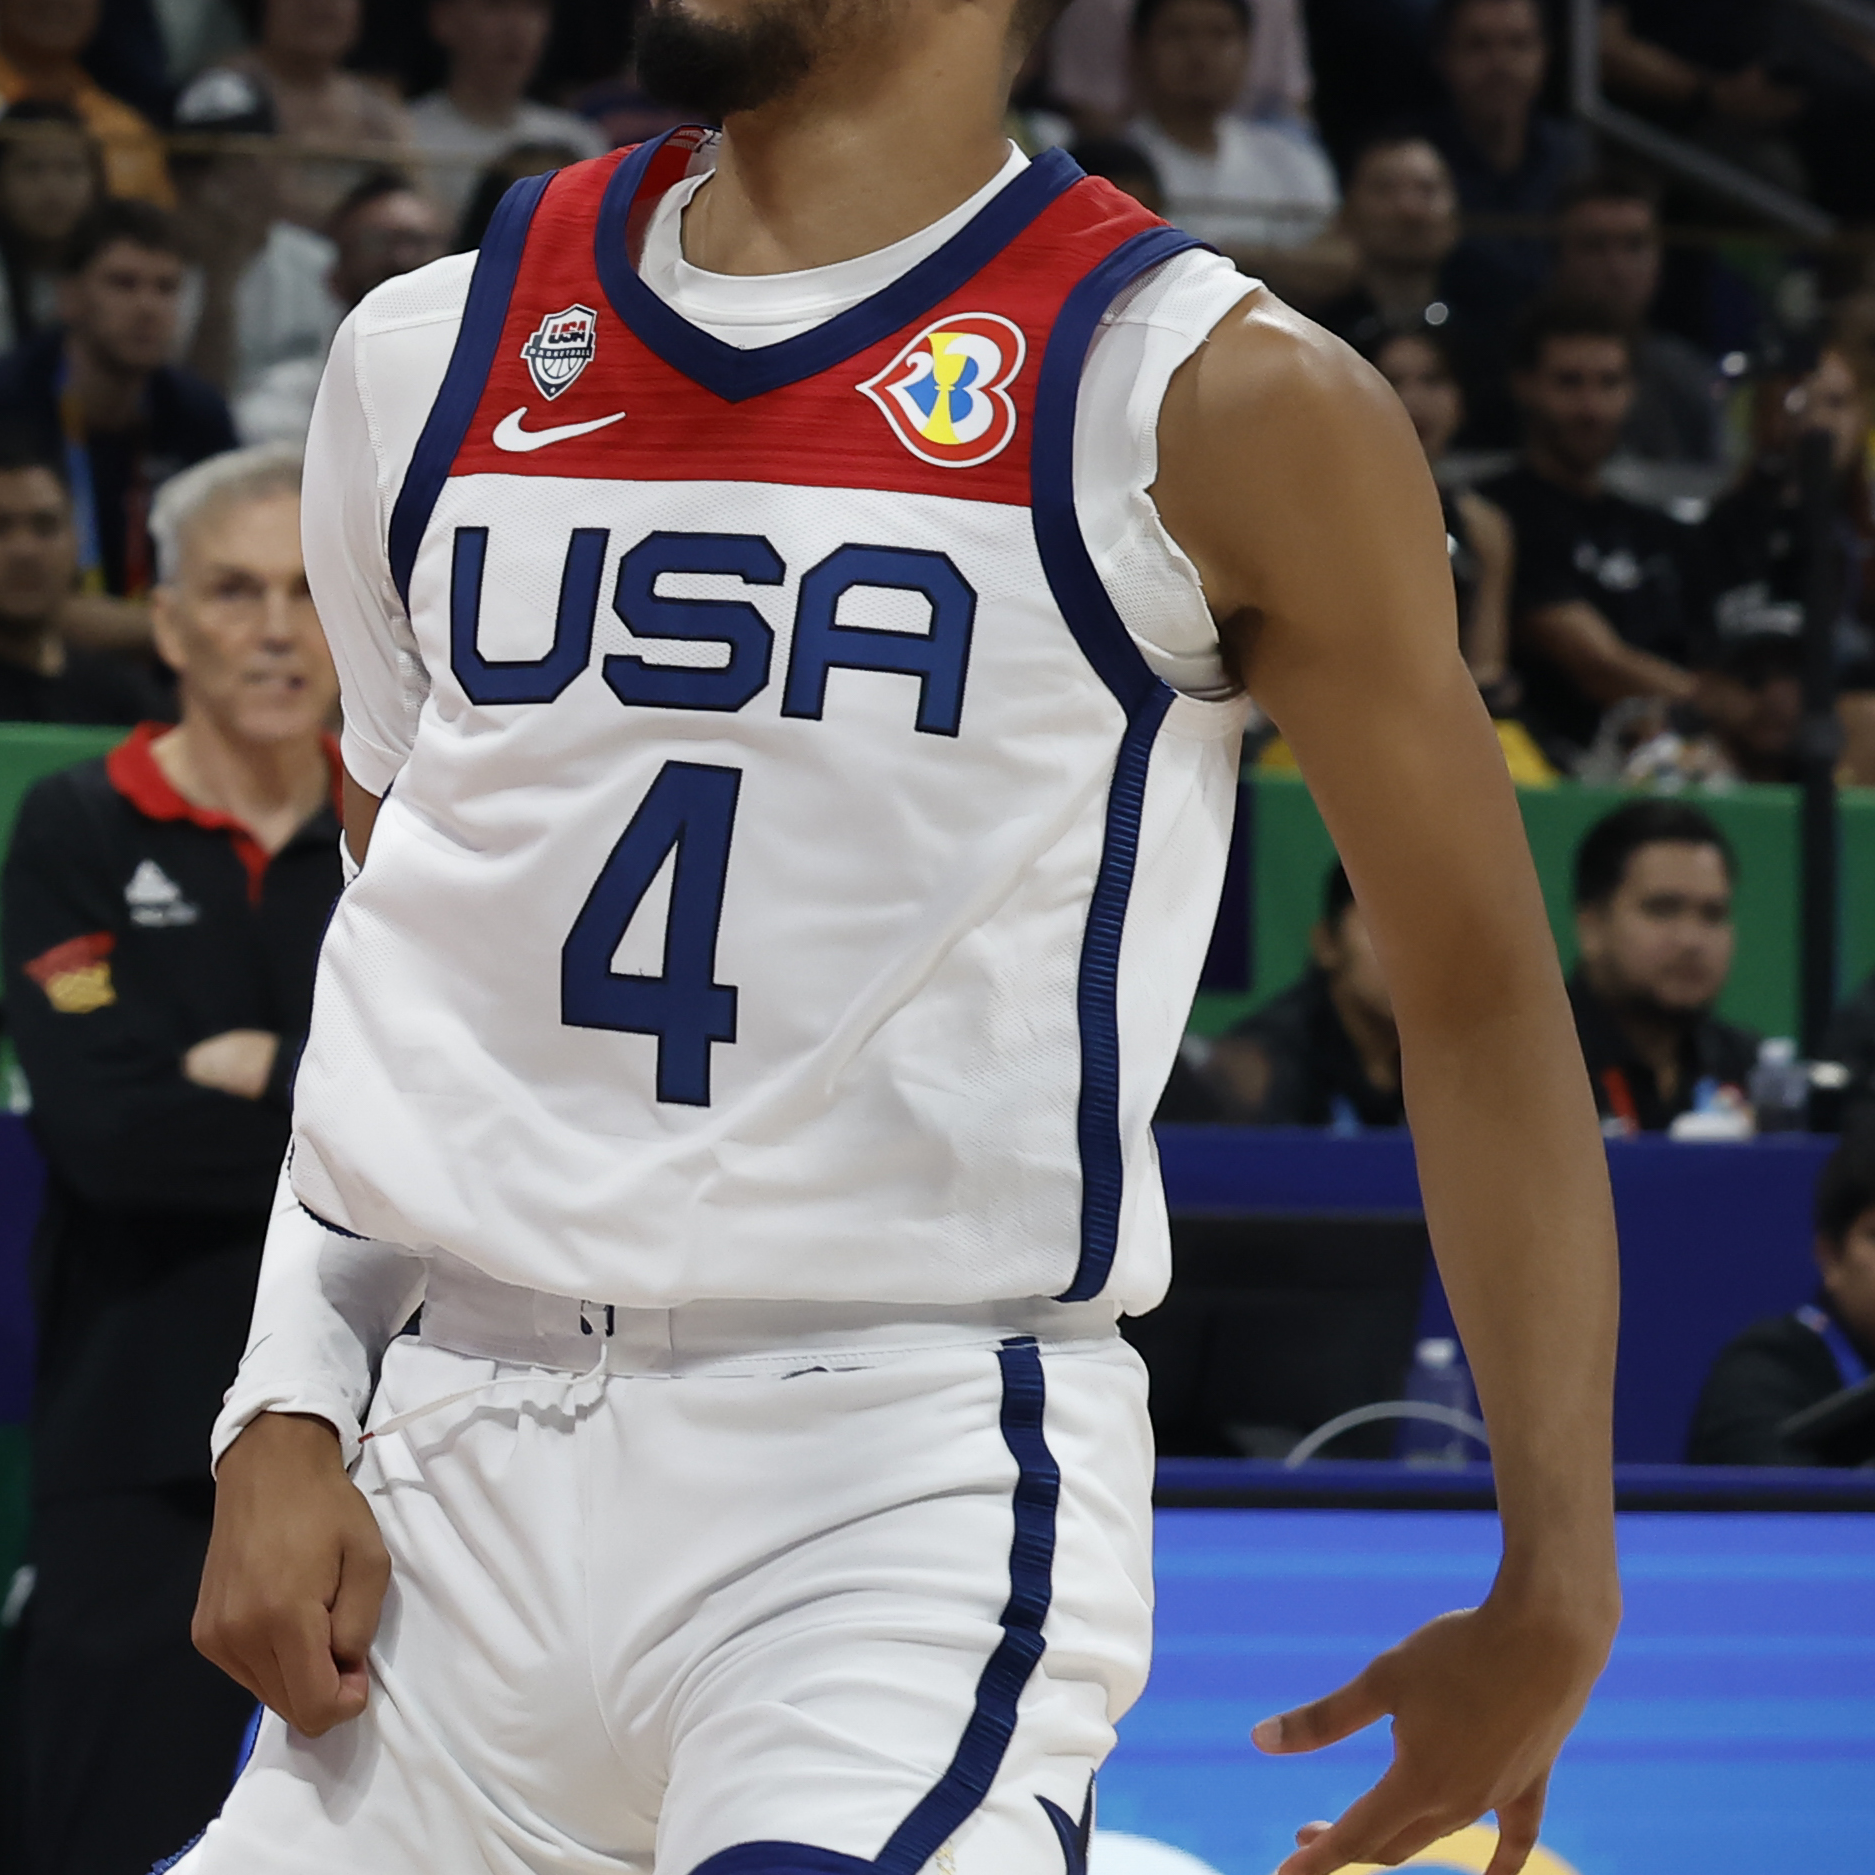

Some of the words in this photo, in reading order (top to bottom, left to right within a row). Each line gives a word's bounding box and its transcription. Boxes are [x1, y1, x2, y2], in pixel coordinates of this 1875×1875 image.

[529, 347, 591, 358] BASKETBALL
[548, 320, 588, 344] USA
[450, 526, 978, 739] USA
[561, 759, 743, 1108] 4
